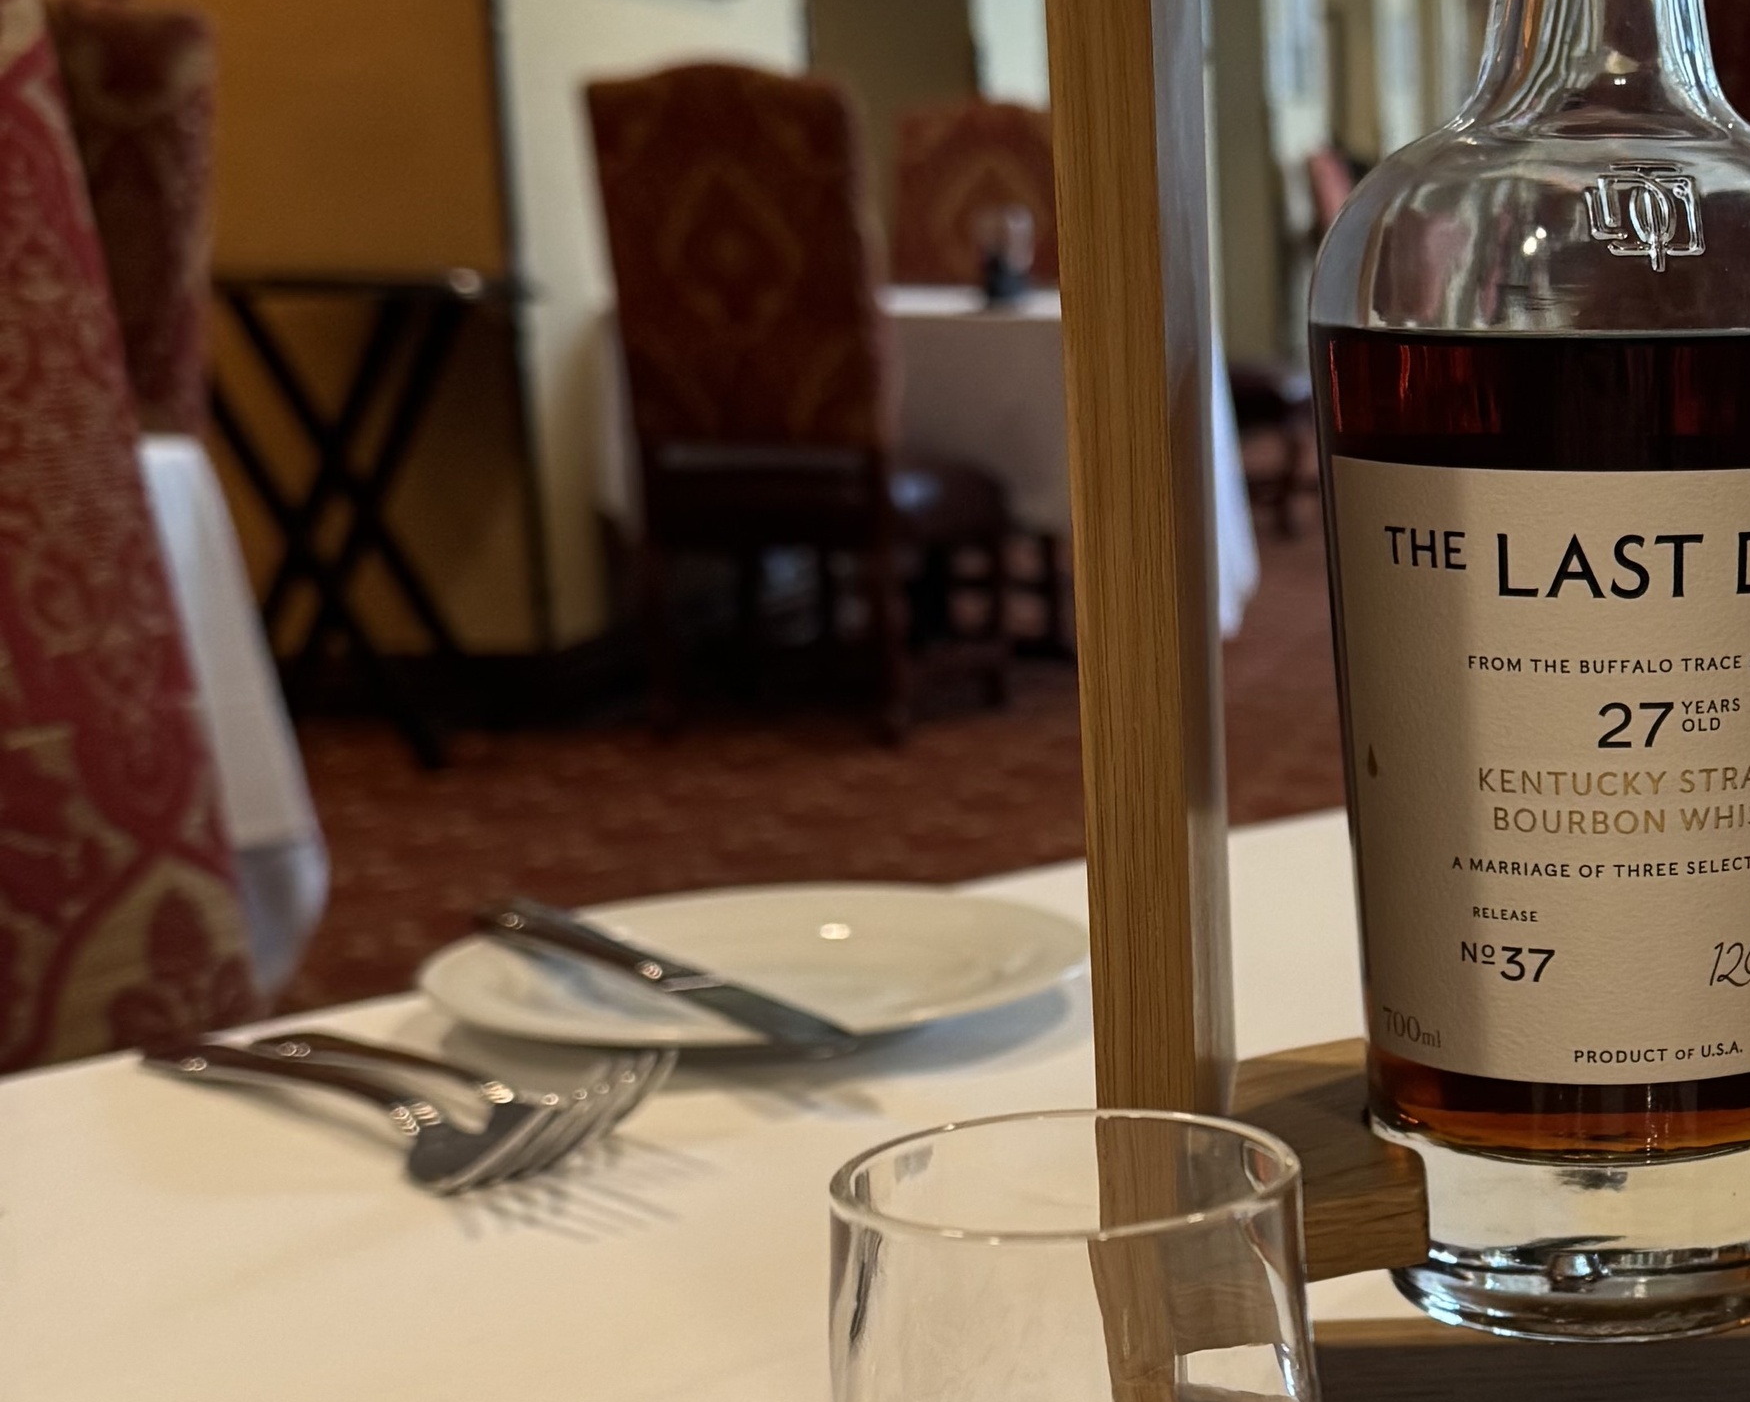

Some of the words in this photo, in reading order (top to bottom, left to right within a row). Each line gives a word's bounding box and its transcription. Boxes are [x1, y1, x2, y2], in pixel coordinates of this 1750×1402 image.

[1383, 525, 1467, 571] THE
[1496, 532, 1704, 599] LAST
[1468, 655, 1522, 673] FROM
[1530, 658, 1571, 674] THE
[1579, 658, 1673, 674] BUFFALO
[1681, 655, 1742, 672] TRACE
[1597, 701, 1675, 749] 27
[1681, 697, 1741, 715] YEARS
[1681, 717, 1721, 733] OLD
[1478, 767, 1667, 797] KENTUCKY
[1493, 806, 1666, 835] BOURBON
[1451, 855, 1463, 871] A
[1469, 857, 1571, 878] MARRIAGE
[1578, 863, 1606, 879] OF
[1613, 861, 1679, 879] THREE
[1472, 905, 1539, 923] RELEASE
[1382, 1005, 1442, 1049] 700ml
[1573, 1048, 1669, 1065] PRODUCT
[1700, 1040, 1744, 1059] U.S.A.
